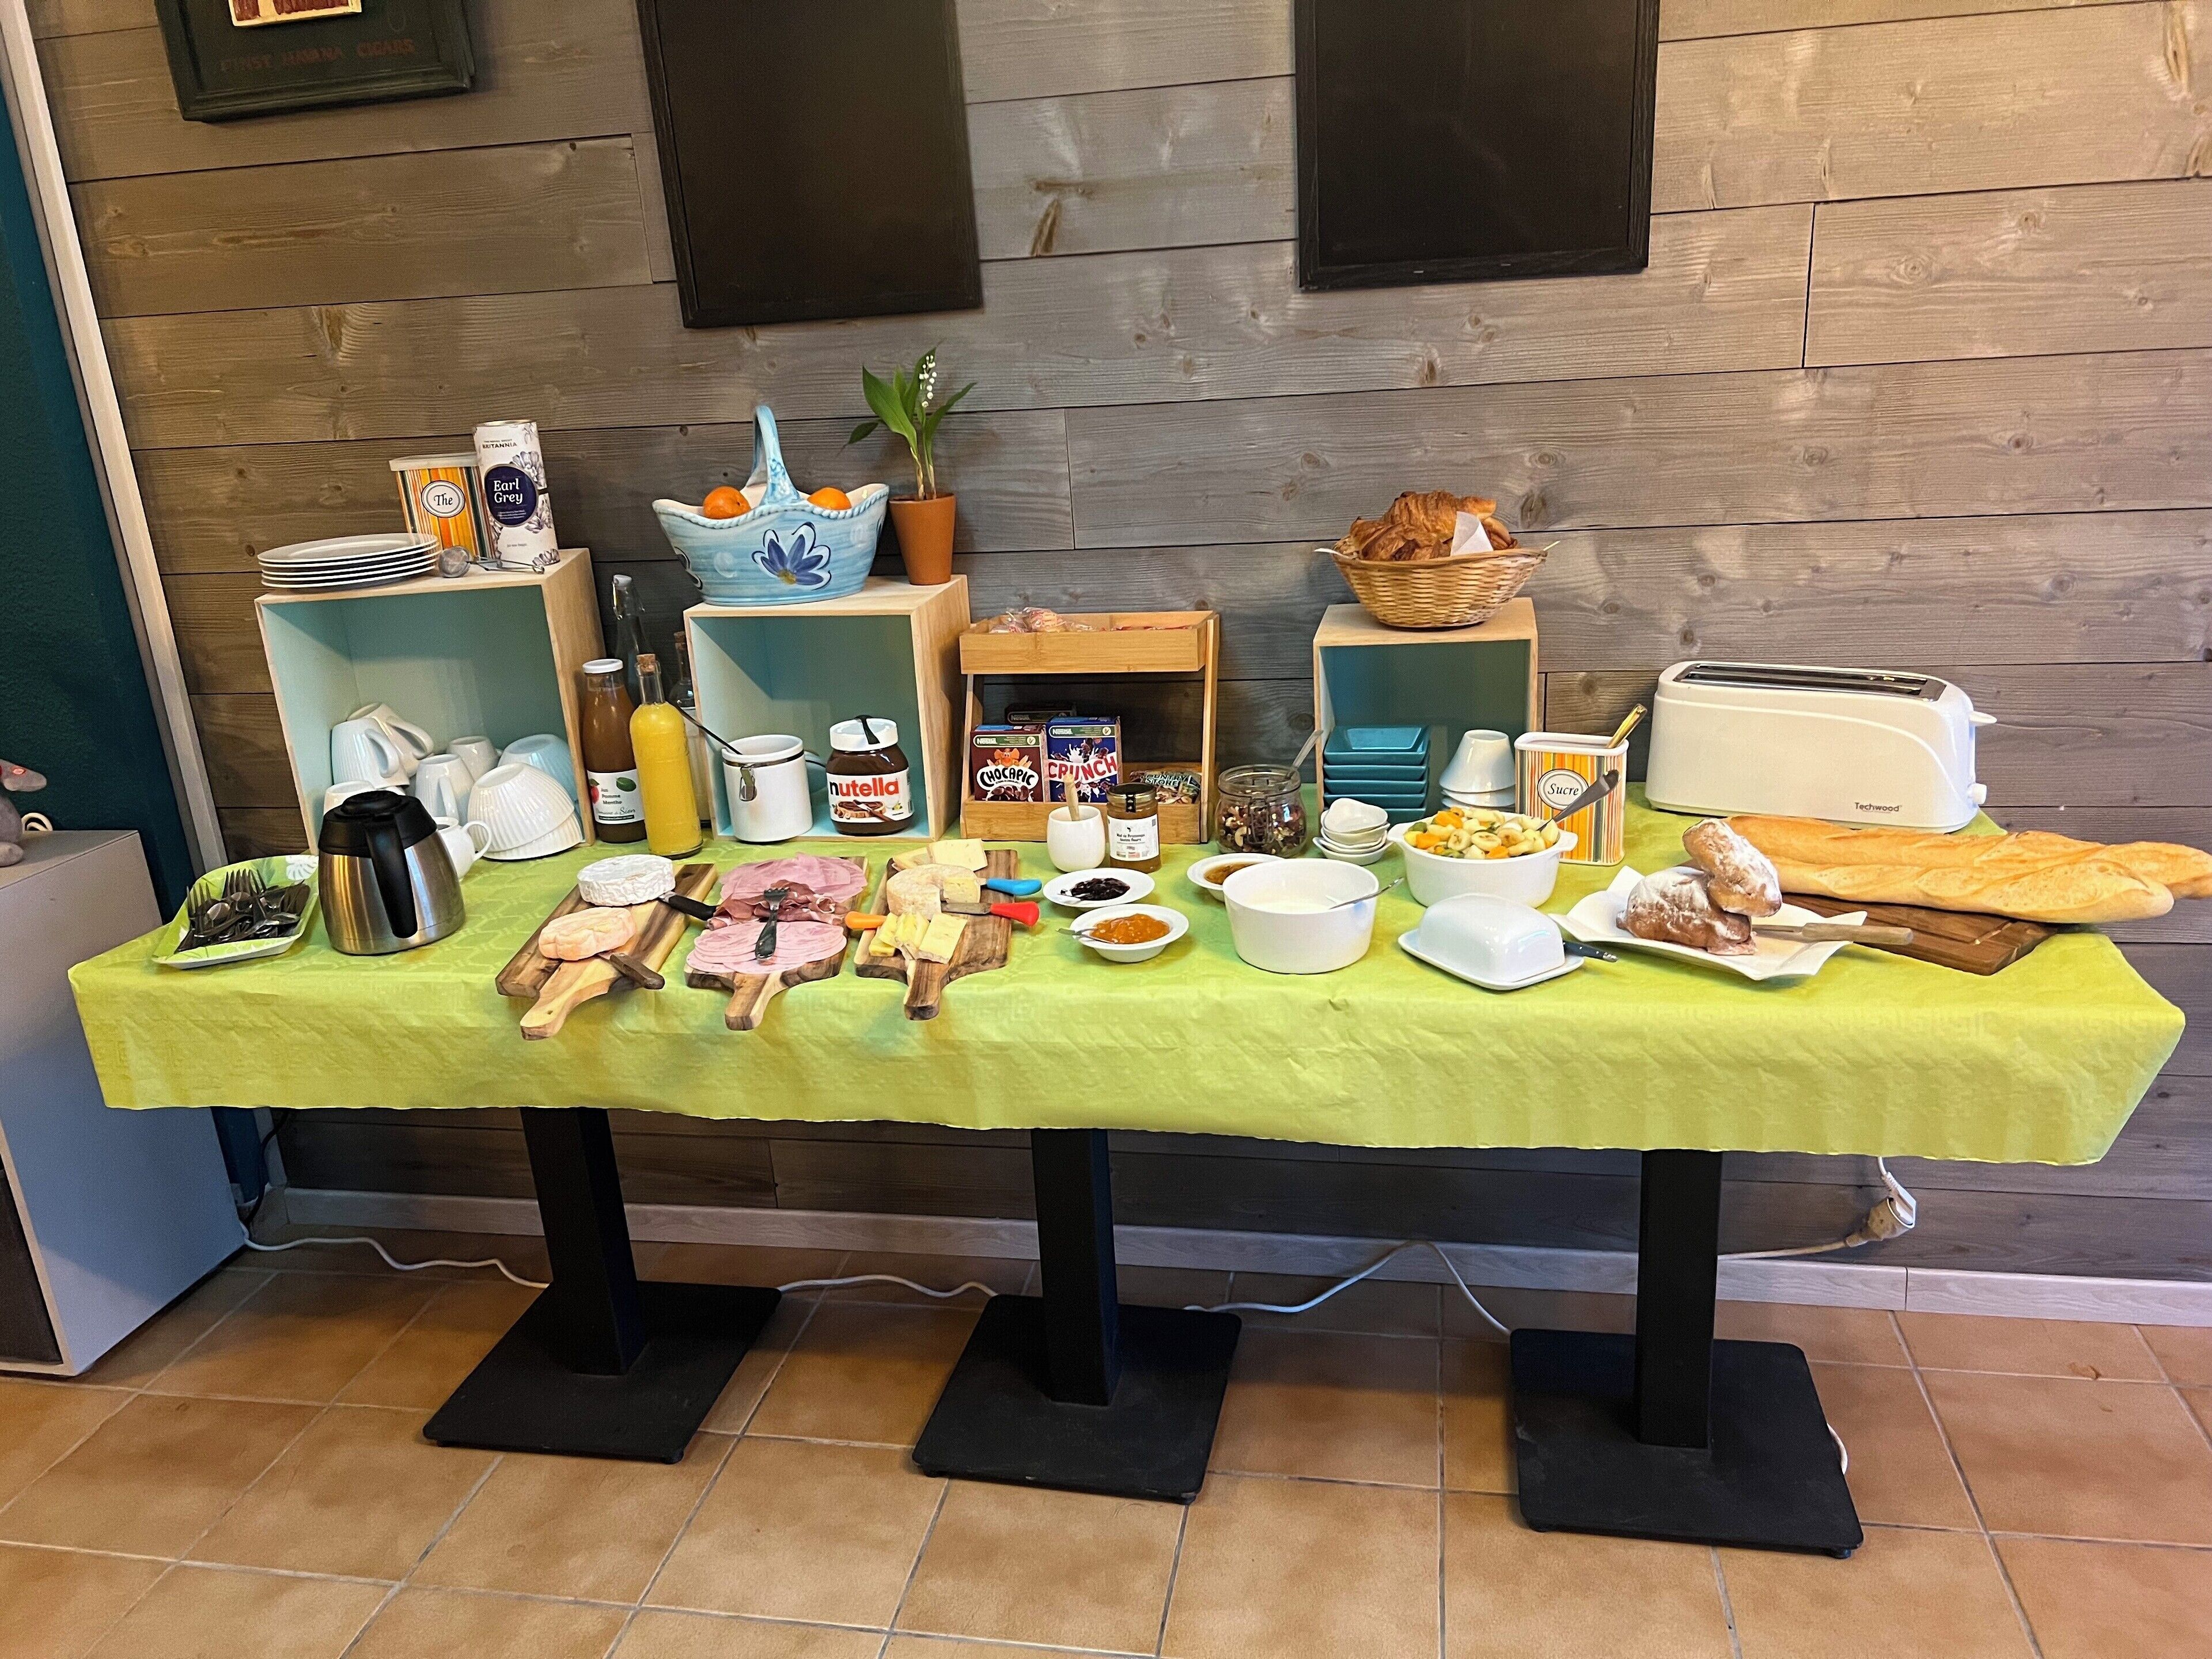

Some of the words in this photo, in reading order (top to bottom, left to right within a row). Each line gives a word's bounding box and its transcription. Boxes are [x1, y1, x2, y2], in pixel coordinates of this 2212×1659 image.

[357, 39, 415, 57] CIGARS
[494, 478, 519, 491] Earl
[494, 493, 523, 505] Grey
[1048, 756, 1117, 781] CRUNCH
[979, 767, 1035, 787] CHOCAPIC
[1145, 778, 1179, 787] STORE
[830, 777, 899, 797] nutella
[1547, 783, 1579, 796] Sucre
[1855, 802, 1899, 812] Techwood
